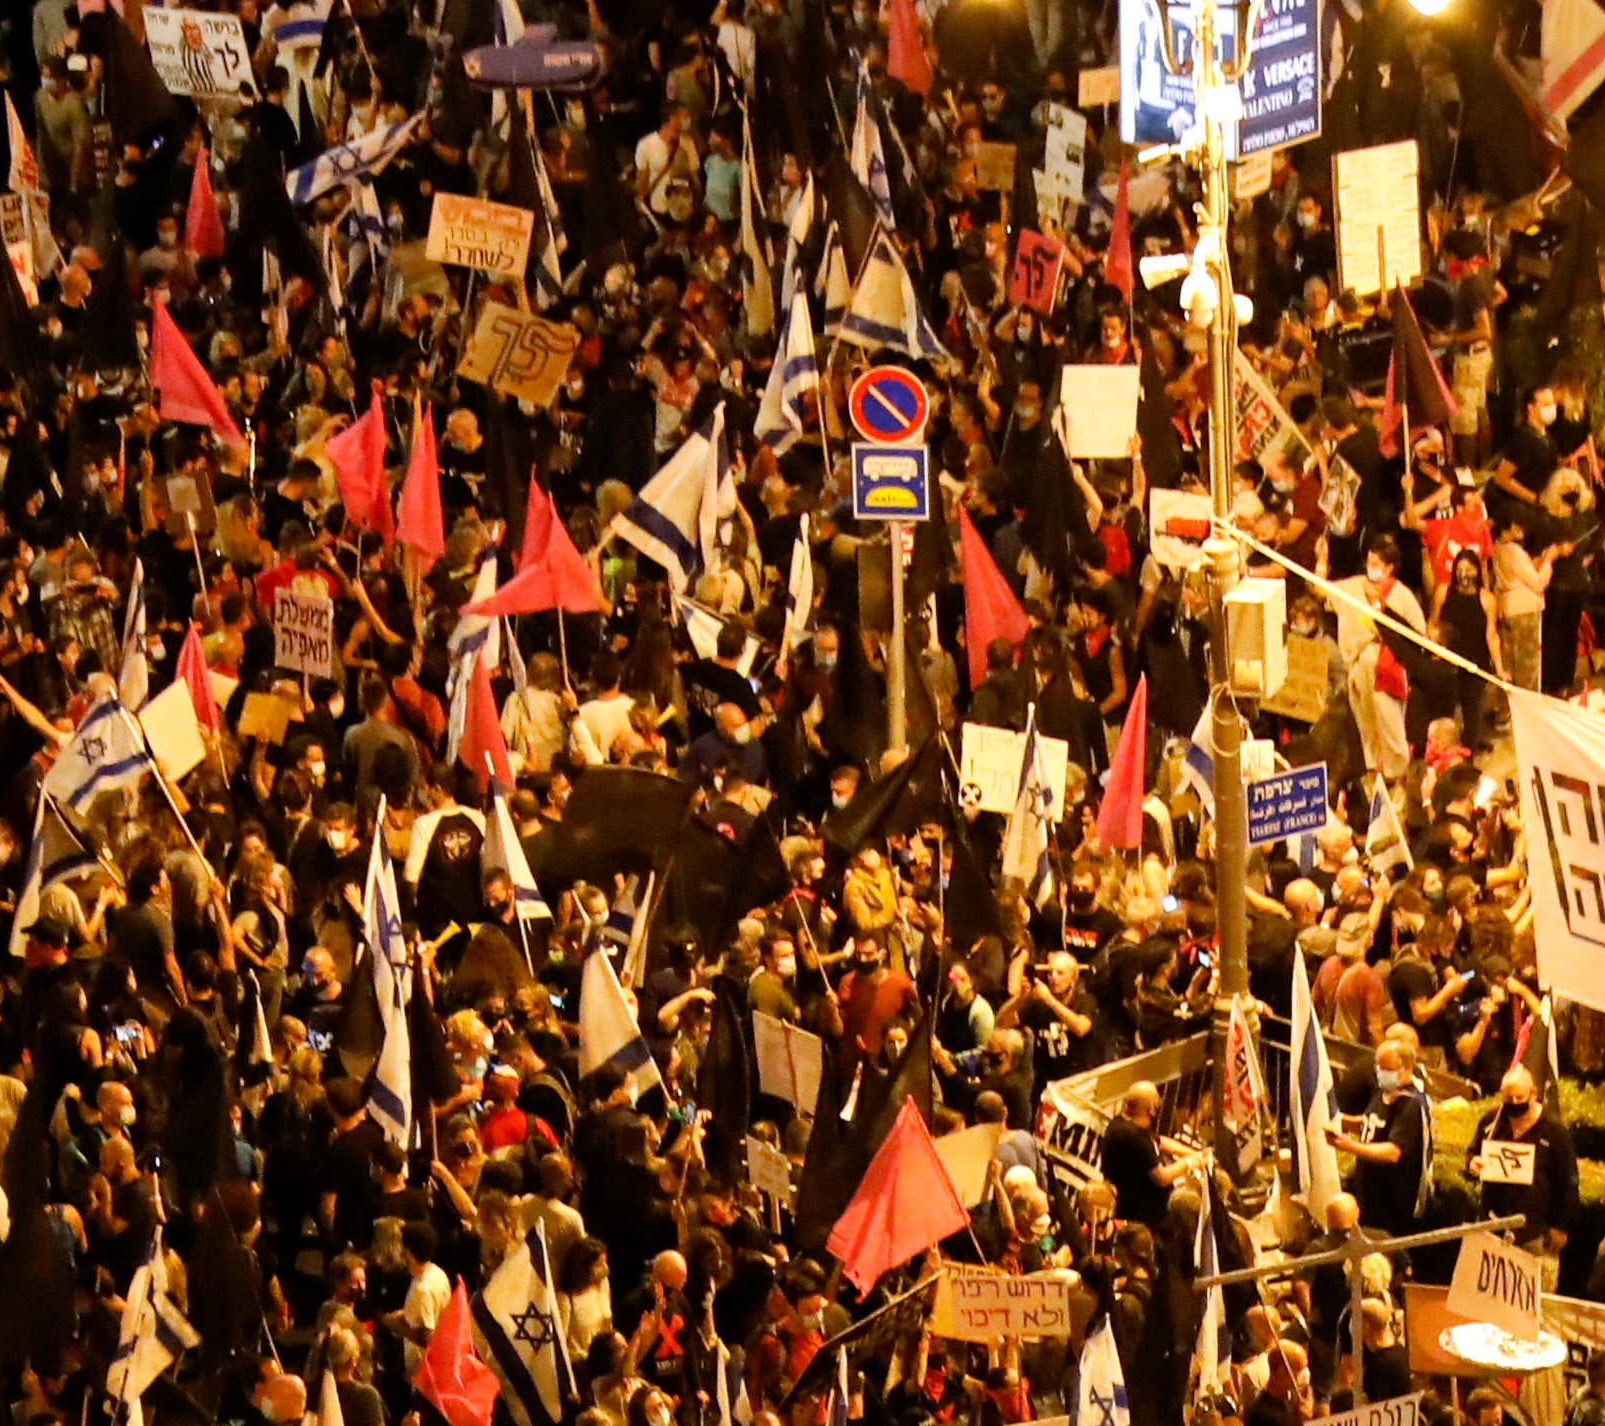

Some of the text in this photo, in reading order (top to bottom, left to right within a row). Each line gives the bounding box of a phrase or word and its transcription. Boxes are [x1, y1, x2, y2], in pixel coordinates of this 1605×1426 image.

[1264, 52, 1315, 83] VERSACE
[490, 317, 576, 388] לך
[279, 628, 330, 665] מאפיה
[1253, 779, 1294, 803] צרפת
[1007, 1279, 1065, 1299] דרוש
[1477, 1248, 1536, 1315] אזרחים
[1022, 1302, 1066, 1329] ולא
